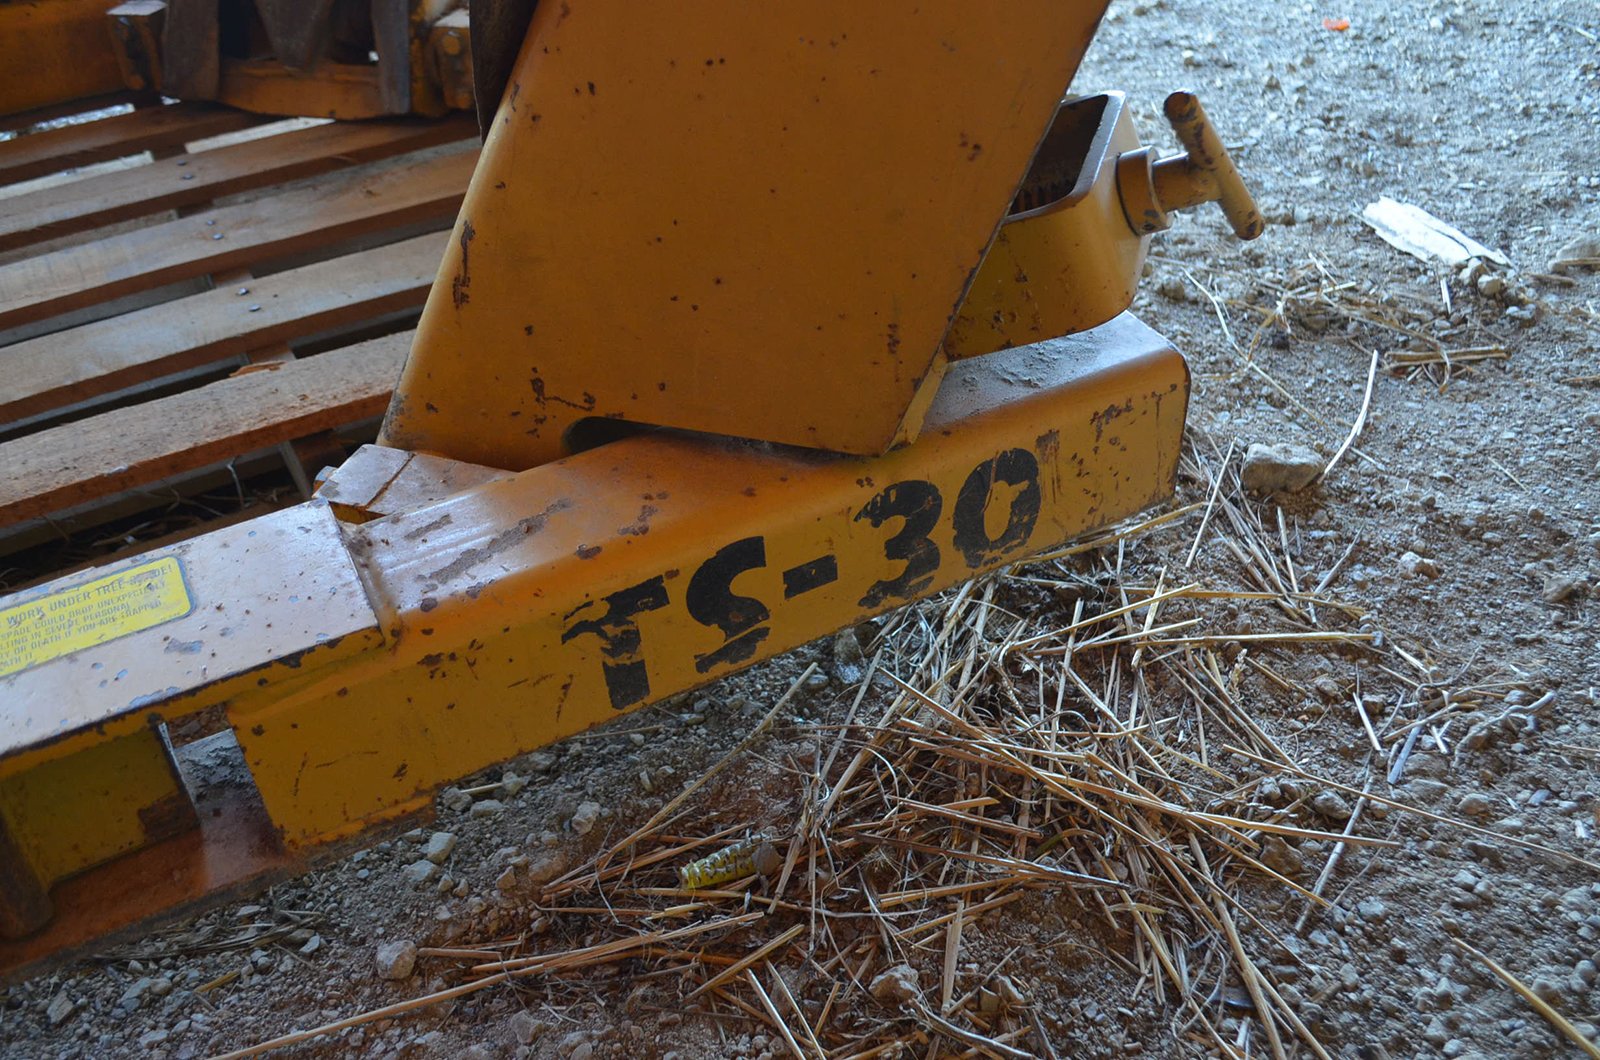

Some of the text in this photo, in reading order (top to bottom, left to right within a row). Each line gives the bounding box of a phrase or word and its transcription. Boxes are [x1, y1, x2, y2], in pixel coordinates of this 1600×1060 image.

[561, 447, 1041, 710] TS-30
[6, 605, 43, 625] WORK
[49, 590, 90, 612] UNDER
[31, 630, 41, 640] IN
[44, 617, 79, 635] SEVERE
[83, 601, 130, 622] PERSONAL
[34, 612, 65, 630] COULD
[68, 604, 93, 619] DROP
[97, 580, 166, 608] UNEXPECTLY
[14, 644, 26, 655] OR
[31, 632, 60, 649] DEATH
